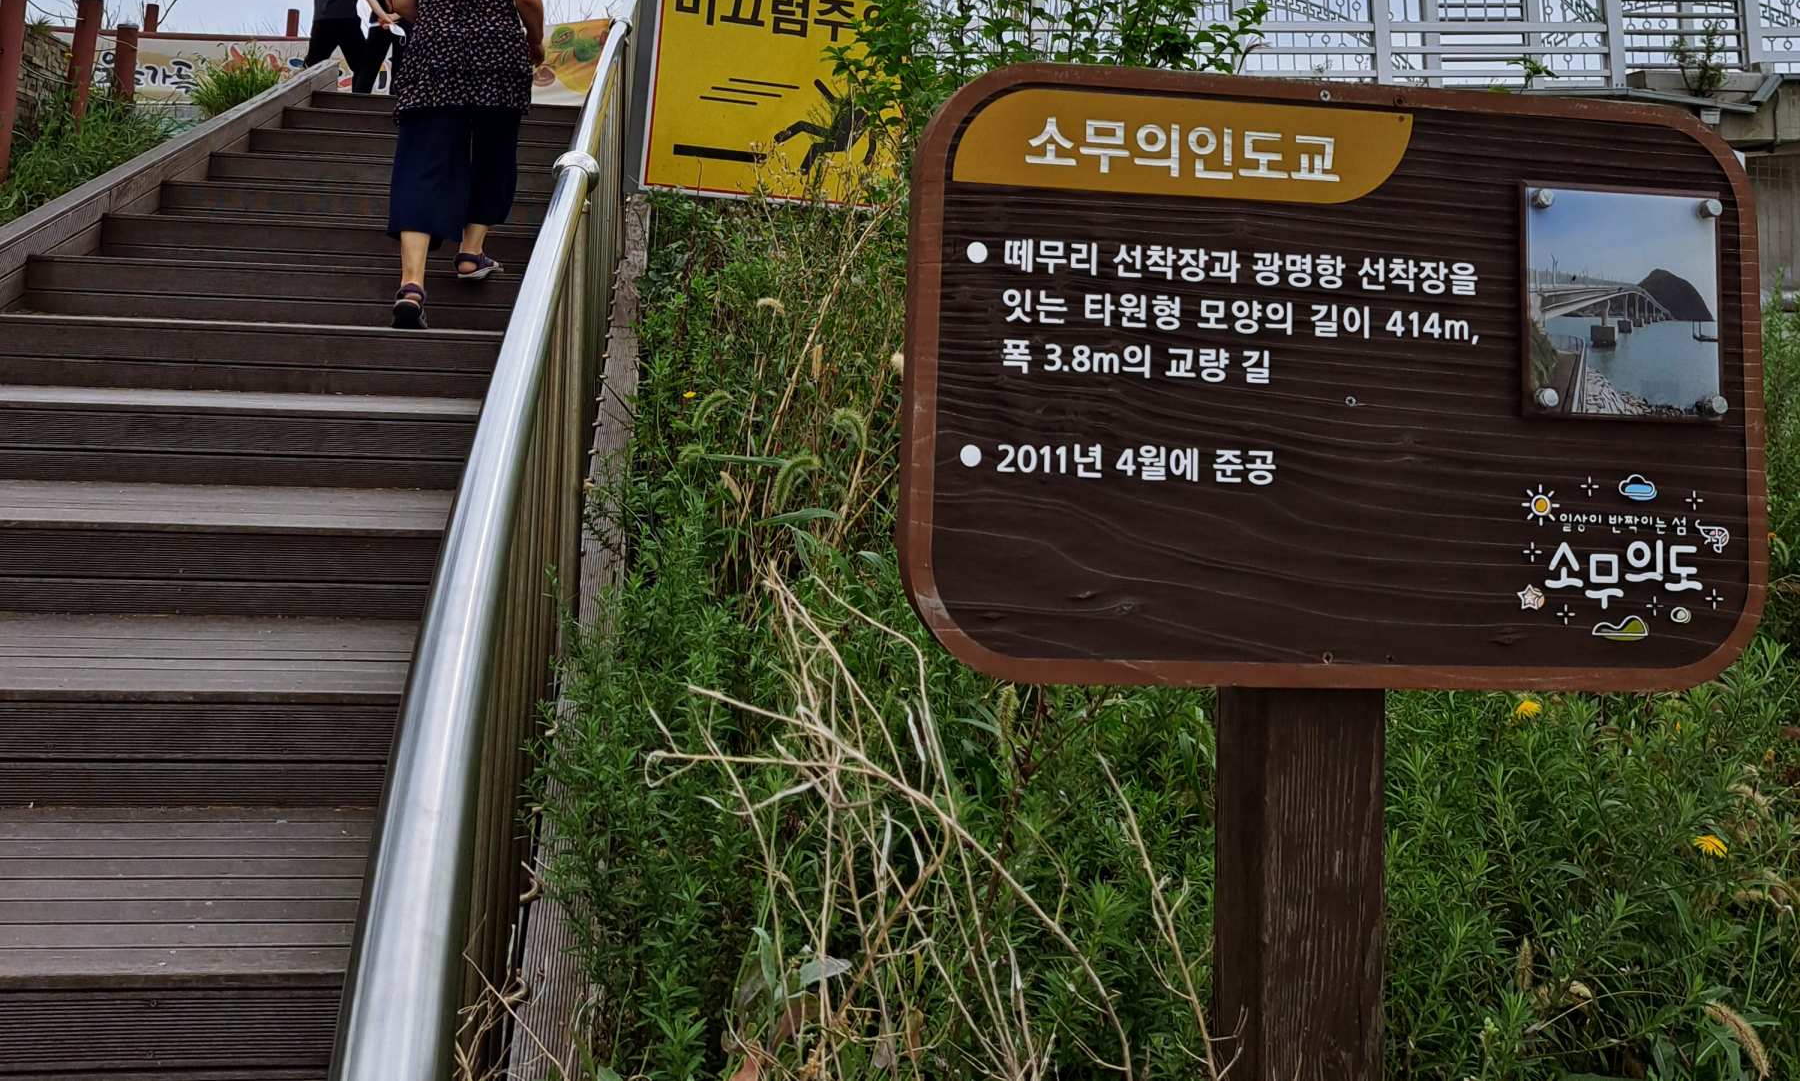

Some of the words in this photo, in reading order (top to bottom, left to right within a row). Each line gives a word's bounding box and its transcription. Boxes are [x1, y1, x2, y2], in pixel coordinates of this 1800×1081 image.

[1024, 116, 1340, 183] 소무의인도교
[1004, 238, 1098, 276] 떼무리
[1112, 244, 1241, 284] 선착장과
[1252, 252, 1346, 289] 광명항
[1357, 257, 1478, 296] 선착장을
[1002, 288, 1068, 324] 잇는
[1084, 293, 1181, 331] 타원형
[1197, 299, 1293, 336] 모양의
[1310, 304, 1370, 339] 길이
[1385, 310, 1479, 345] 414m,
[1002, 339, 1032, 374] 폭
[1043, 343, 1151, 379] 3.8m의
[1165, 348, 1230, 383] 교량
[1241, 350, 1270, 384] 길
[996, 443, 1102, 479] 2011년
[1115, 445, 1199, 482] 4월에
[1212, 449, 1276, 485] 준공
[1559, 513, 1602, 533] 일상이
[1608, 515, 1667, 535] 반짝이는
[1672, 516, 1687, 536] 섬
[1543, 538, 1704, 611] 소무의도
